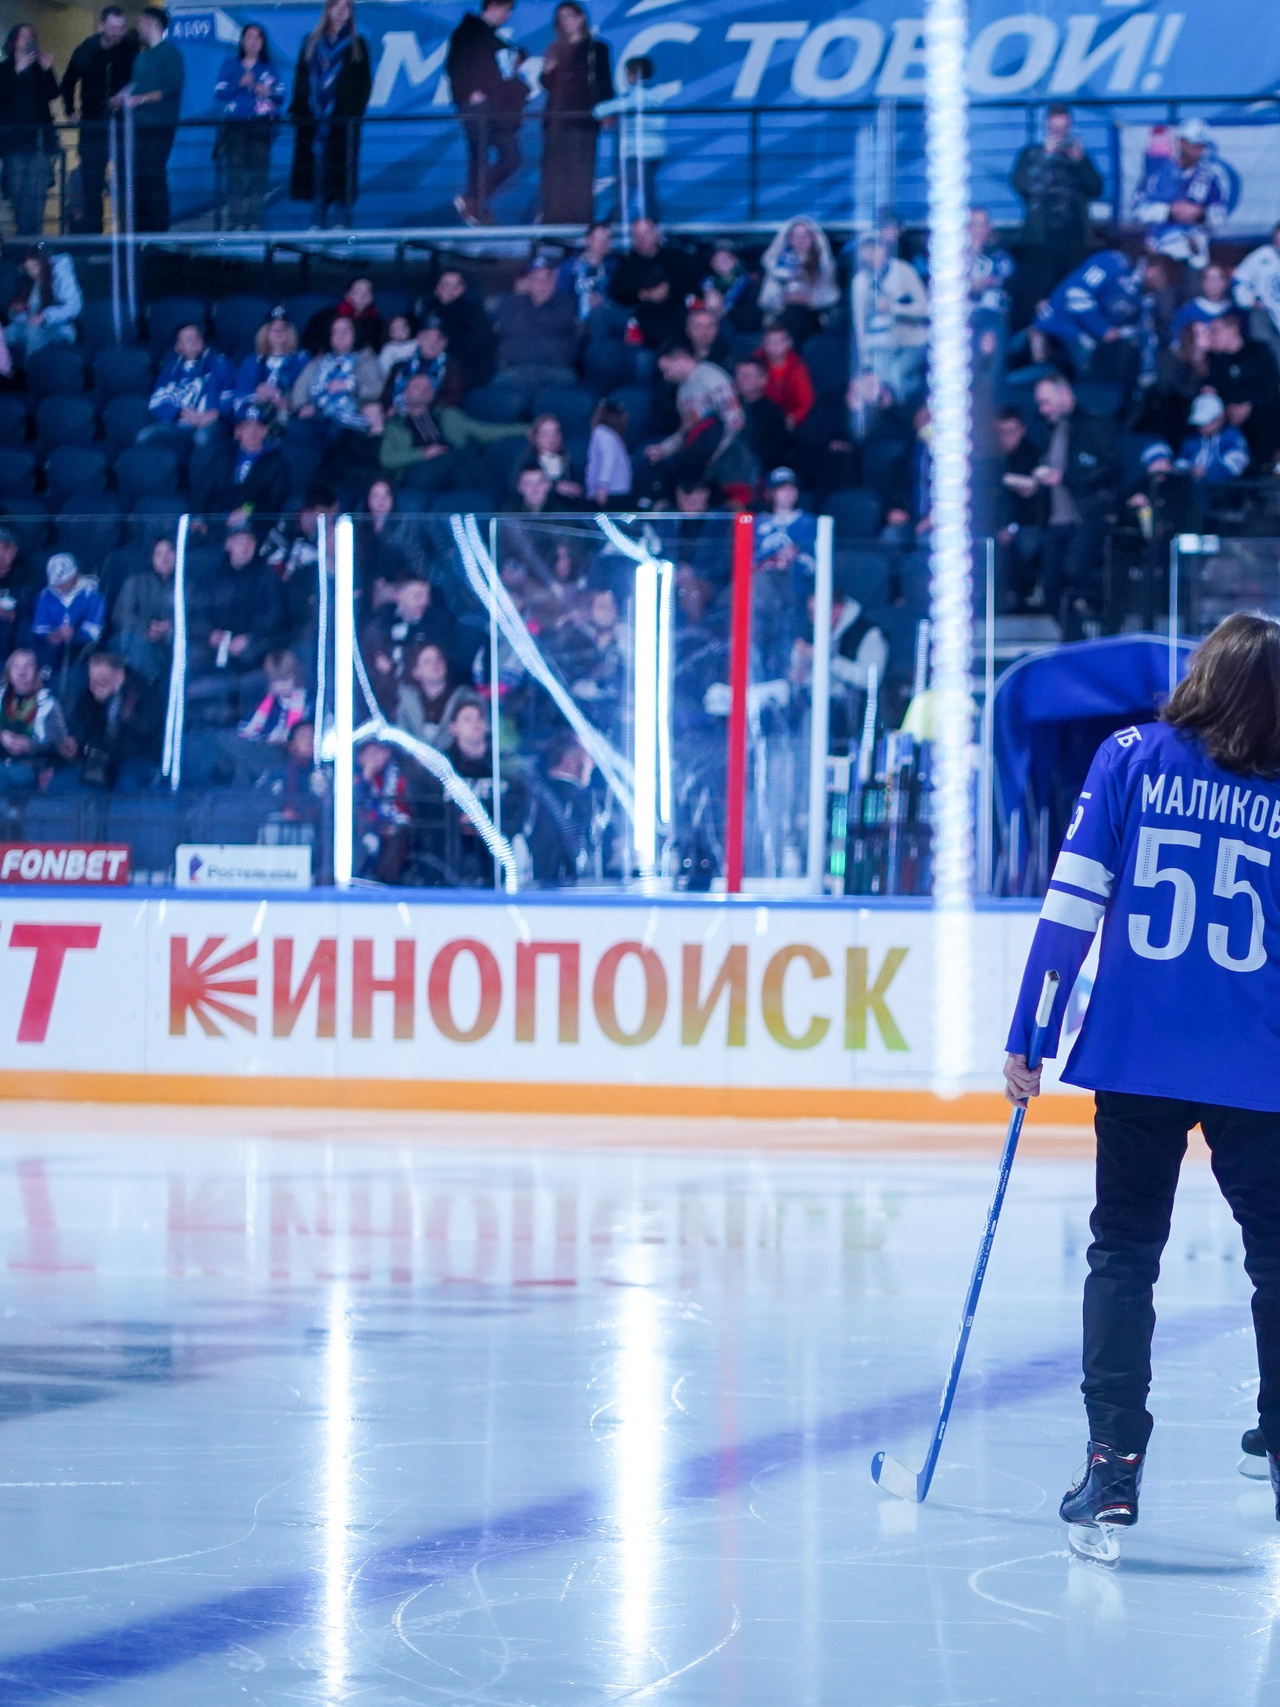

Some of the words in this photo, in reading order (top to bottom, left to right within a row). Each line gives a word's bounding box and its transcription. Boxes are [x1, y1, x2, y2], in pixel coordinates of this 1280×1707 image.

[0, 849, 128, 880] FONBET
[1128, 826, 1272, 973] 55
[168, 934, 911, 1051] КИНОПОИСК
